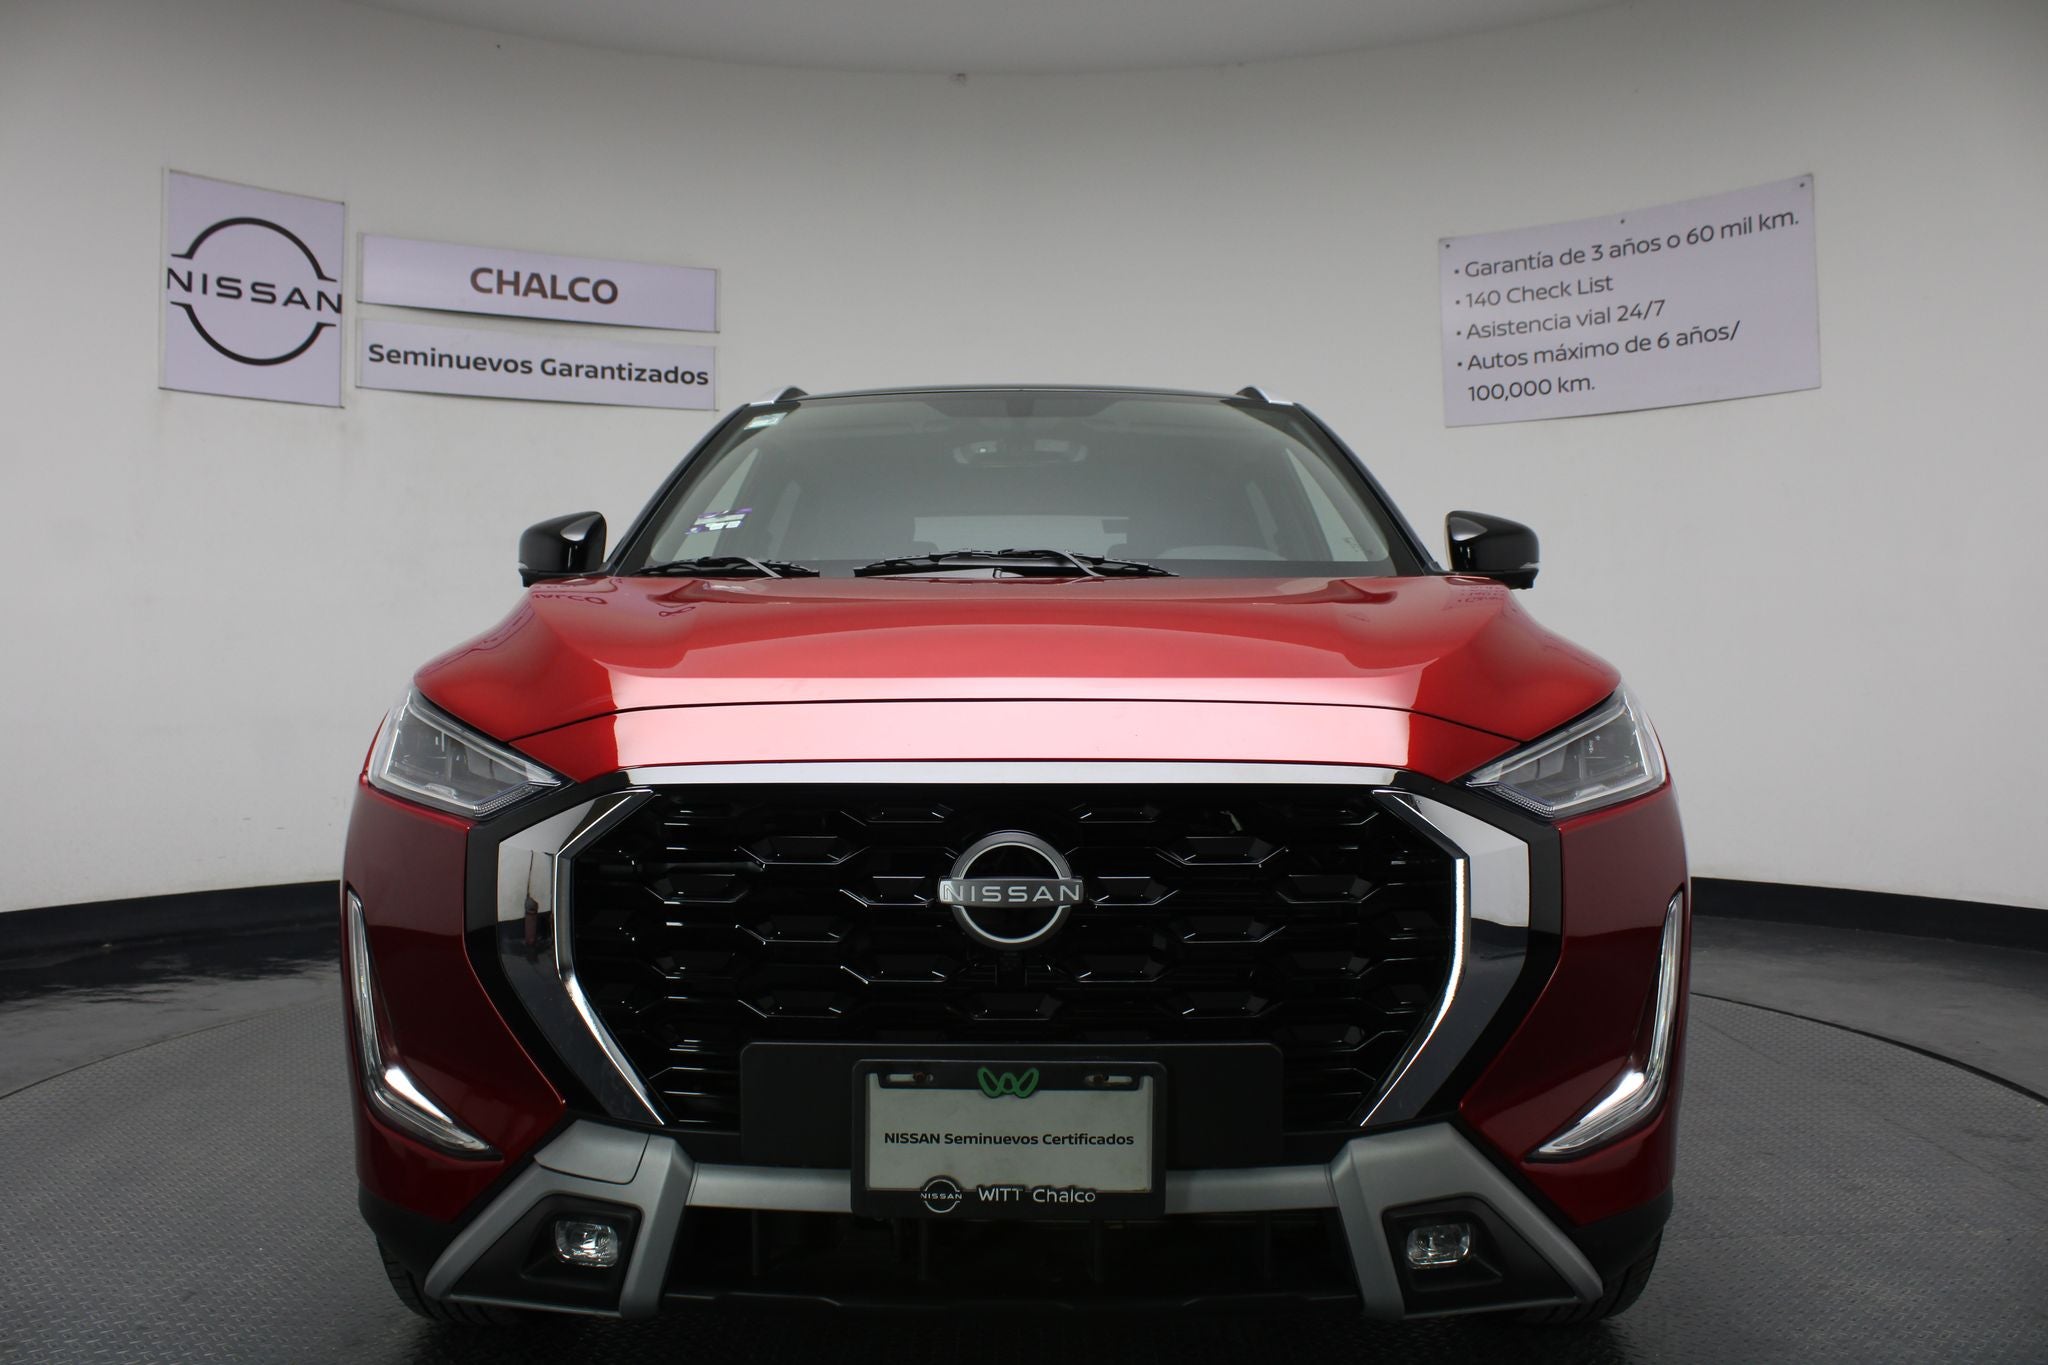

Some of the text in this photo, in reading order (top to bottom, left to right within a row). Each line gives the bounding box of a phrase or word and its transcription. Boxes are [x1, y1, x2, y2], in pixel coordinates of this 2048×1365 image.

[1465, 209, 1799, 277] Garantía de 3 años o 60 mil km.
[167, 267, 342, 314] NISSAN
[470, 267, 619, 304] CHALCO
[1466, 275, 1613, 307] 140 Check List
[1466, 298, 1666, 339] Asistencia vial 24/7
[1468, 320, 1740, 370] Autos máximo de 6 años/
[368, 343, 709, 386] Seminuevos Garantizados
[1468, 375, 1595, 402] 100,000 km.
[944, 885, 1079, 902] NISSAN
[884, 1132, 1134, 1145] NISSAN Seminuevos Certificados
[921, 1191, 962, 1200] NISSAN
[978, 1188, 1096, 1203] WITT Chalco
